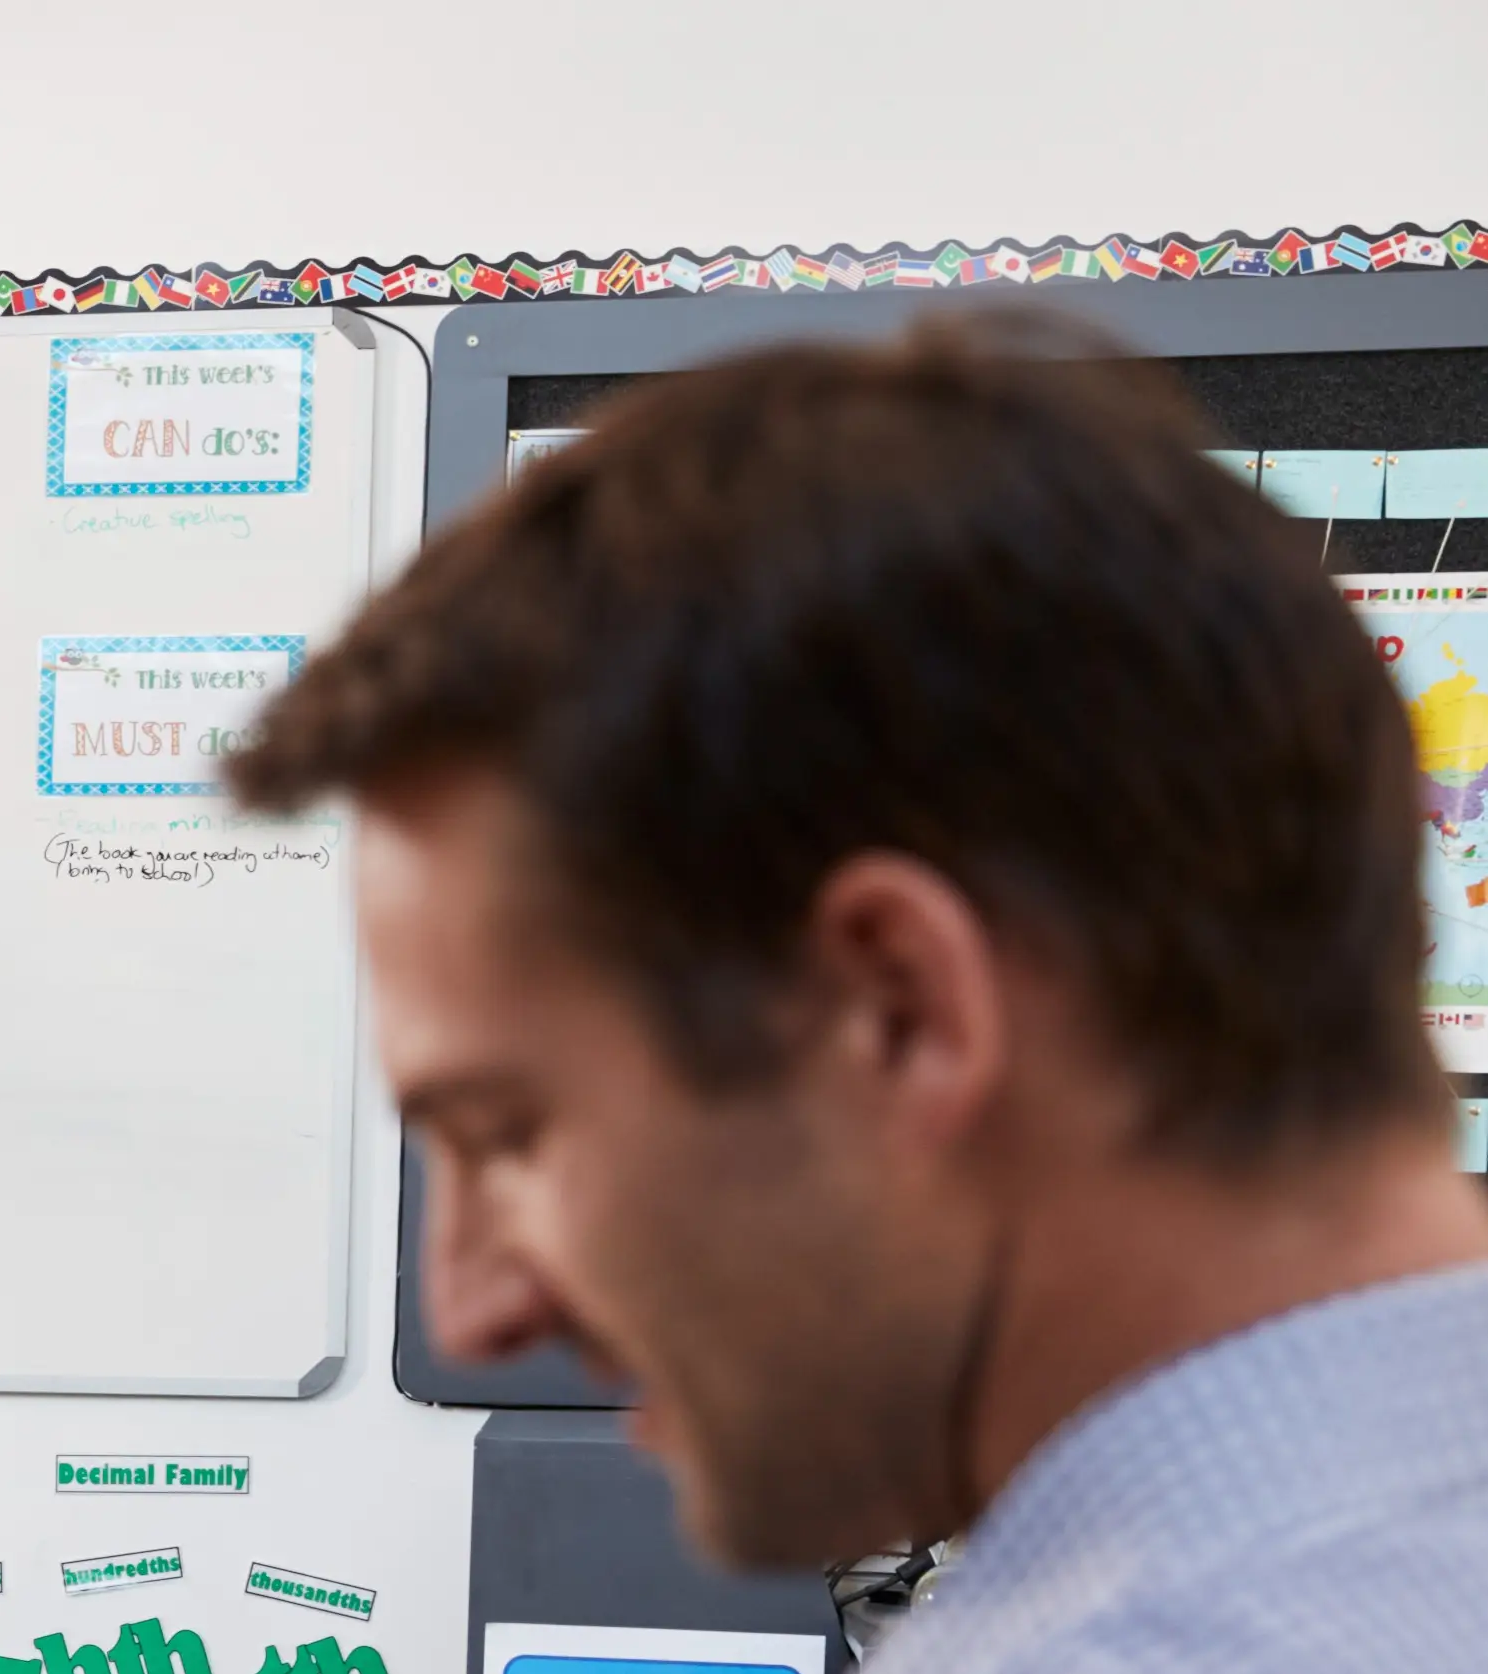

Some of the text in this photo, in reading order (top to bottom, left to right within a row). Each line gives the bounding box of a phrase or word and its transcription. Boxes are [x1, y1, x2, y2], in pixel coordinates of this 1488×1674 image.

[142, 364, 276, 386] This week's
[103, 418, 281, 459] CAN do's:
[61, 506, 159, 535] Creative
[136, 668, 268, 690] This week's
[70, 720, 187, 757] MUST
[203, 850, 258, 874] reading
[57, 1461, 249, 1491] Decimal Family
[62, 1554, 182, 1590] hundredths
[250, 1570, 373, 1615] thousandths
